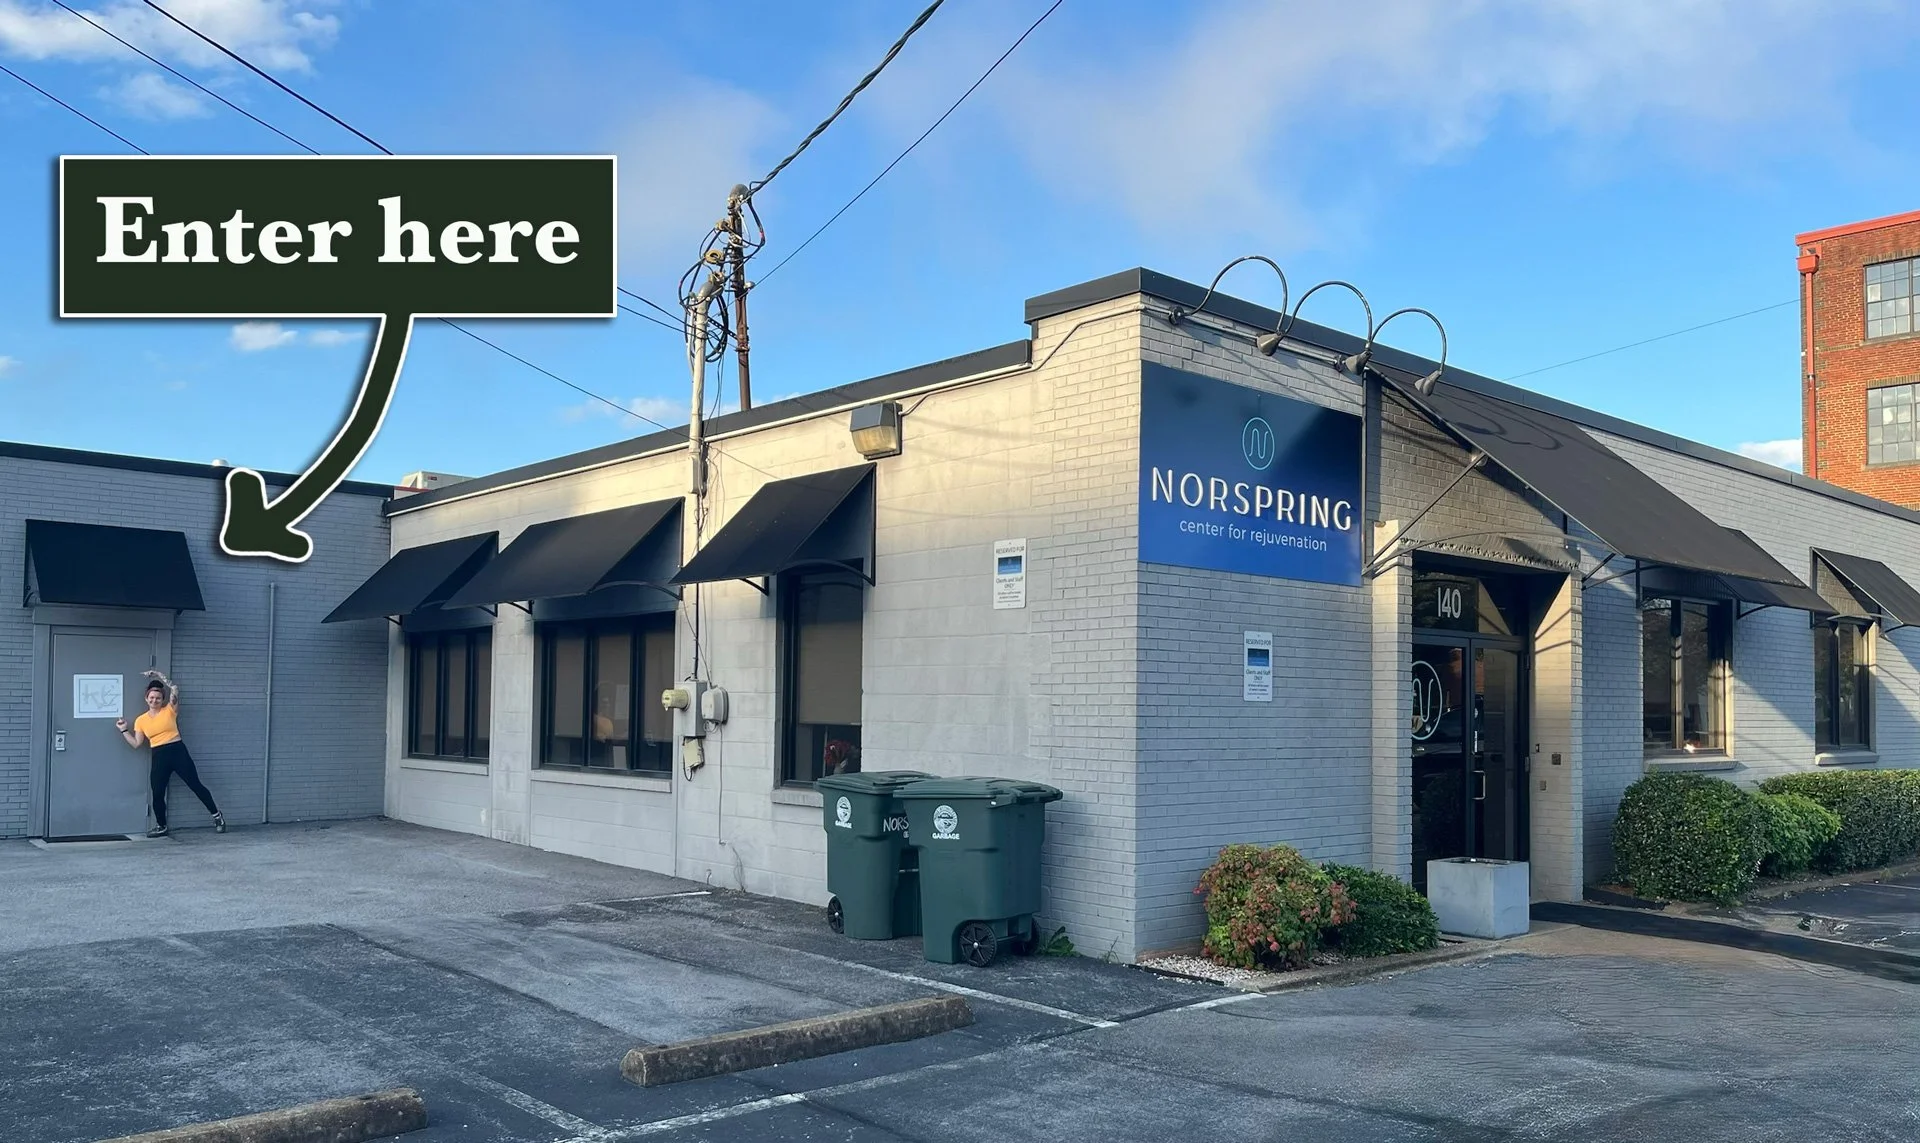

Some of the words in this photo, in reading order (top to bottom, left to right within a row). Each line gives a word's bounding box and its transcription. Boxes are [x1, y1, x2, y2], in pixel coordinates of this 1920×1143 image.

[1152, 466, 1352, 532] NORSPRING
[1179, 519, 1225, 537] center
[1228, 523, 1247, 541] for
[1250, 529, 1328, 552] rejuvenation
[1437, 587, 1462, 619] 140
[932, 832, 960, 840] GARBAGE
